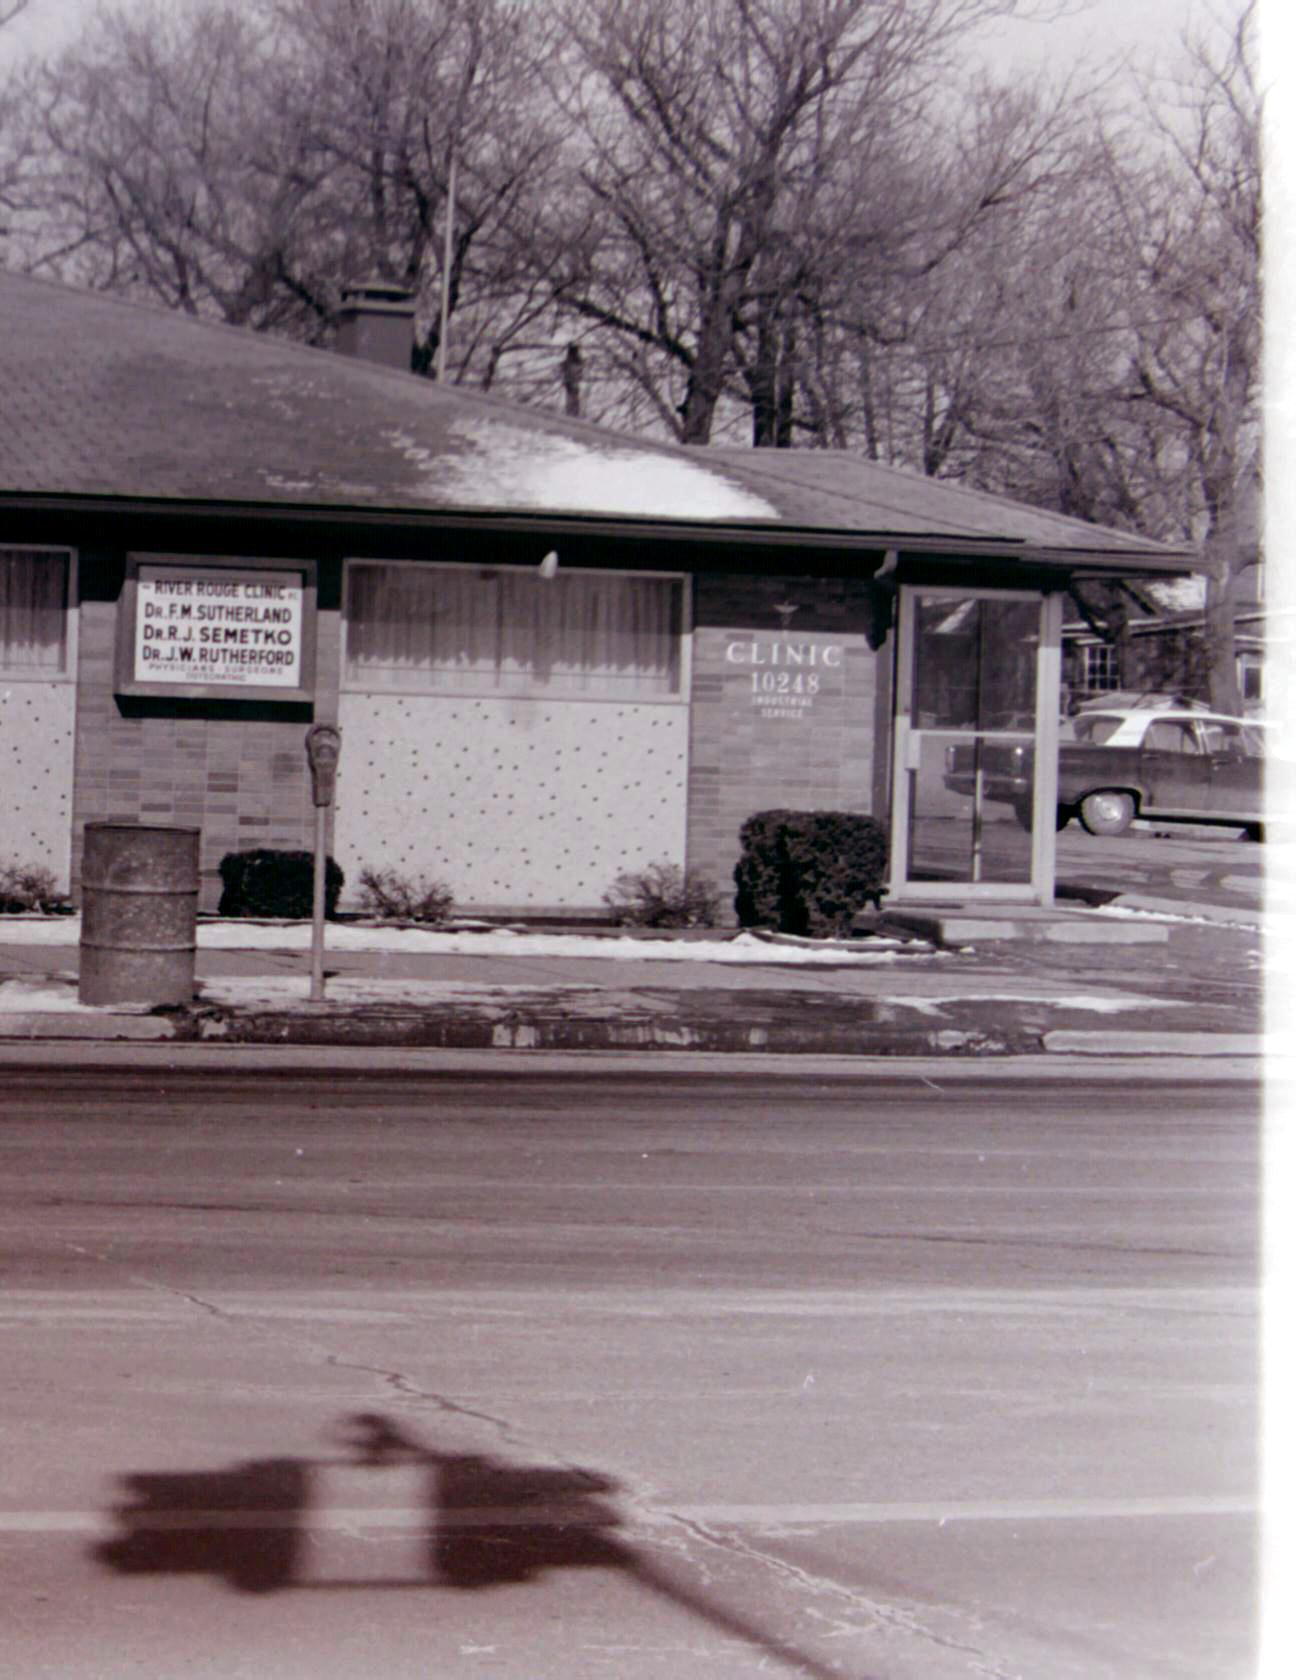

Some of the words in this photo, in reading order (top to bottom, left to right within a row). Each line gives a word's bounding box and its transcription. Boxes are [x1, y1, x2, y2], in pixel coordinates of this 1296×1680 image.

[155, 580, 193, 597] RIVER
[197, 582, 239, 599] ROUGE
[244, 584, 286, 601] CLINIC
[197, 605, 292, 624] SUTHERLAND
[199, 626, 292, 645] SEMETKO
[199, 648, 294, 666] RUTHERFORD
[726, 641, 841, 667] CLINIC
[751, 671, 820, 694] 10248
